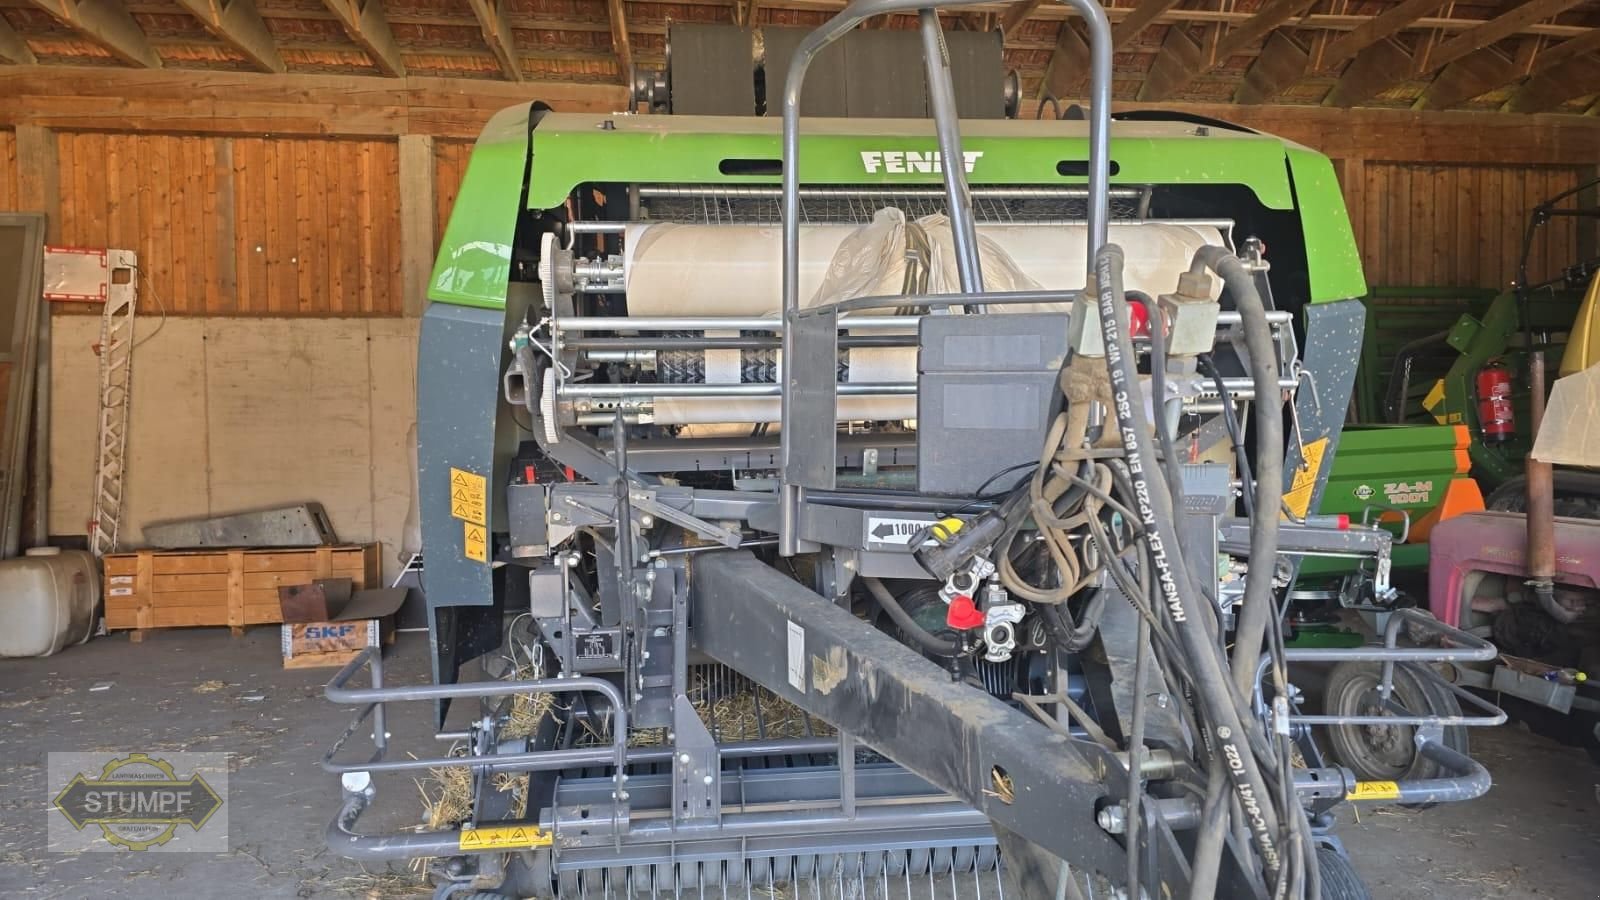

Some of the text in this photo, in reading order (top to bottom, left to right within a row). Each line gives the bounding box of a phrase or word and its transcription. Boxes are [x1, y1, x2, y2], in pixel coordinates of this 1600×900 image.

[1102, 291, 1113, 316] BAR
[1105, 320, 1118, 341] 215
[1108, 343, 1121, 365] WP
[1112, 369, 1125, 385] 19
[1116, 391, 1132, 420] 2SC
[1123, 427, 1138, 450] 857
[1128, 453, 1142, 474] EN
[1384, 481, 1432, 494] ZA-M
[1388, 492, 1428, 504] 1001
[1135, 481, 1155, 525] KP220
[1147, 531, 1187, 622] HANSA-FLEX
[305, 625, 355, 639] SKF
[1223, 743, 1246, 777] 1Q22
